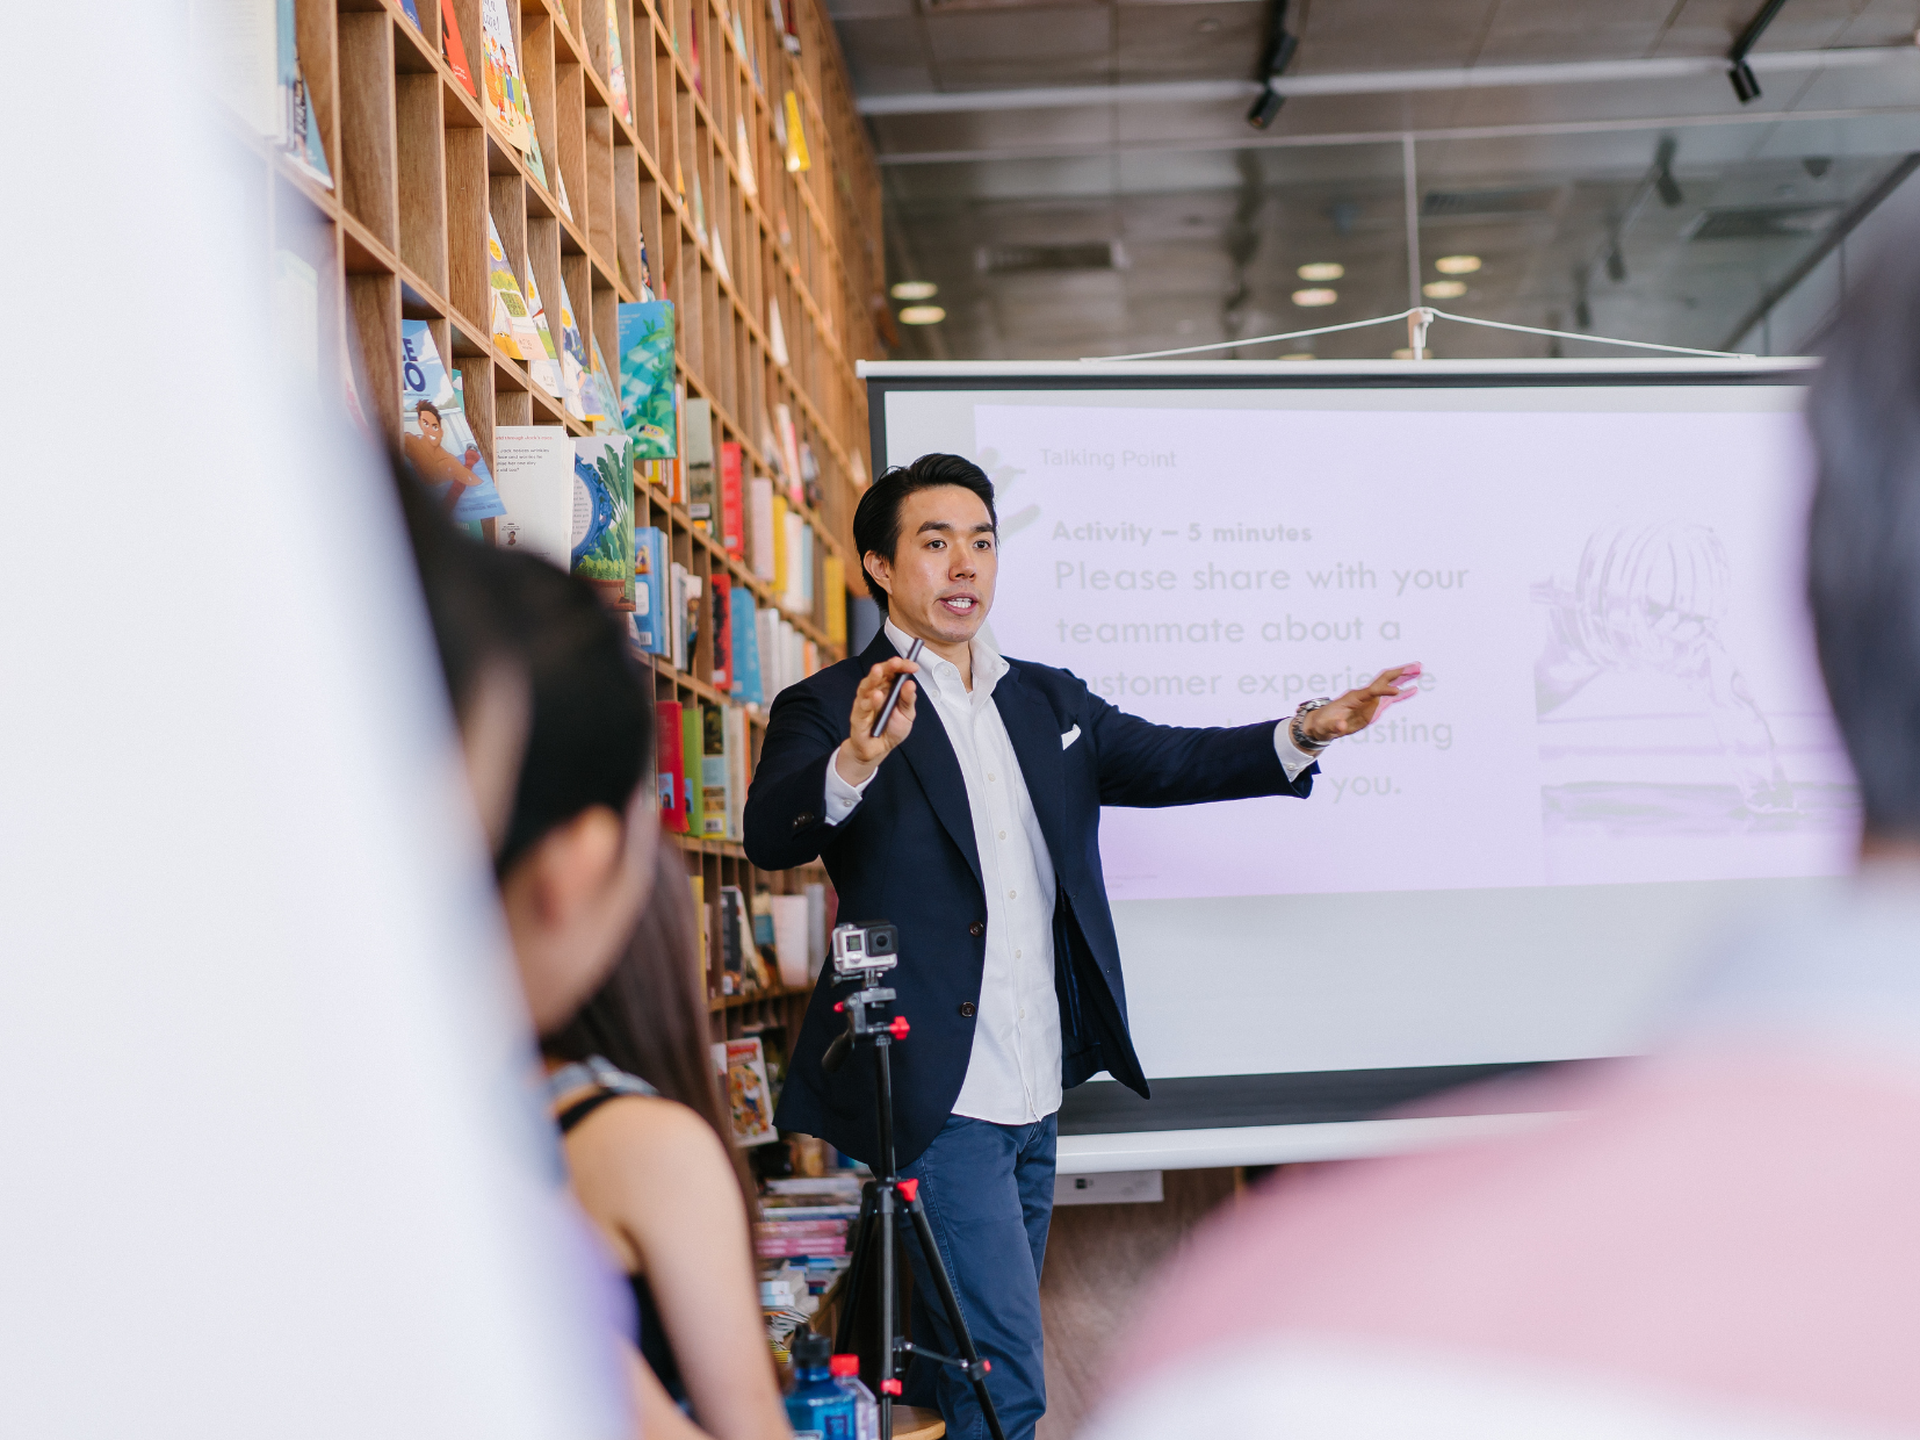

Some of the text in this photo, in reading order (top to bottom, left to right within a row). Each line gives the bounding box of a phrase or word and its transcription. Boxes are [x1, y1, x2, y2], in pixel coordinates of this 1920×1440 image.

[1041, 448, 1176, 470] Talking Point
[1051, 520, 1153, 547] Activity
[1188, 521, 1202, 542] 5
[1212, 521, 1313, 542] minutes
[1054, 560, 1469, 597] Please share with your
[1055, 614, 1402, 643] teammate about a
[1090, 665, 1437, 702] stomer experiee
[1339, 716, 1454, 751] asting
[1329, 775, 1402, 804] you.
